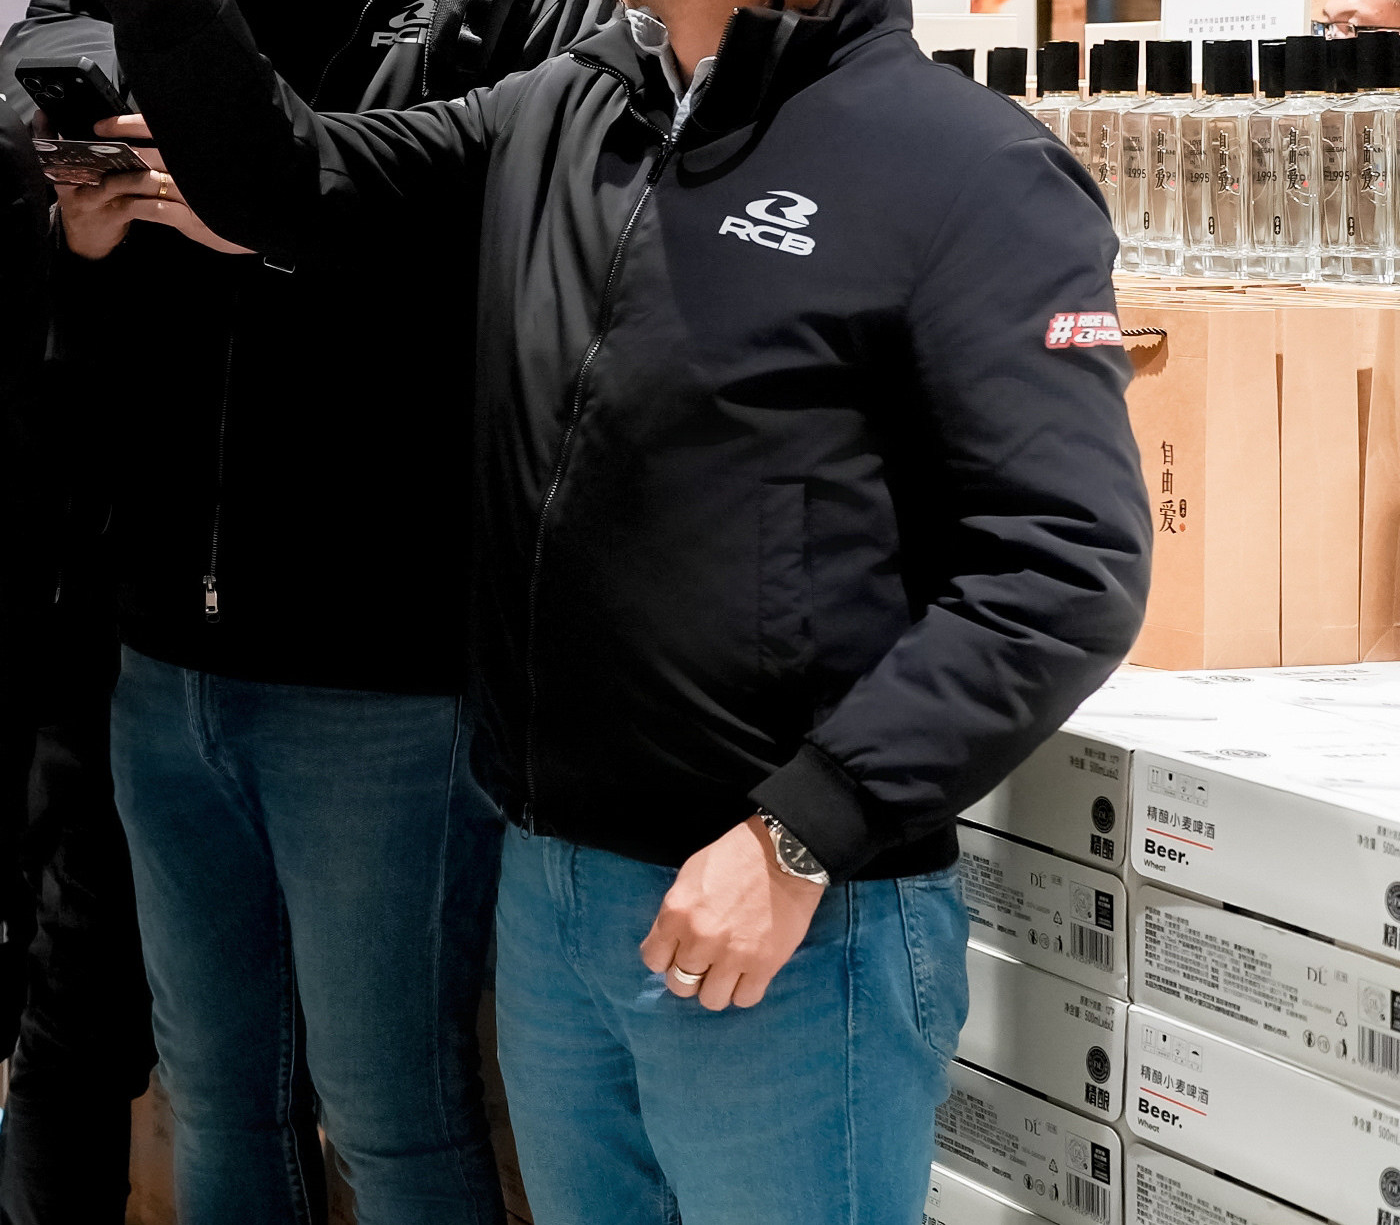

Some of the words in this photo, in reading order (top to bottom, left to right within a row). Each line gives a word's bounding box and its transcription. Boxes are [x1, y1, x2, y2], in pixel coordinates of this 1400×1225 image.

[1127, 168, 1147, 179] 1995
[1189, 172, 1210, 183] 1995
[1256, 171, 1277, 182] 1995
[718, 215, 816, 256] RCB
[1159, 440, 1177, 534] 自由爱
[1147, 805, 1215, 840] 精酿小麦啤酒
[1090, 834, 1115, 862] 精酿
[1144, 838, 1189, 866] Beer.
[1143, 858, 1166, 872] Wheat
[1084, 1082, 1110, 1112] 精酿
[1140, 1064, 1209, 1106] 精酿小麦啤酒
[1137, 1117, 1160, 1133] Wheat
[1138, 1096, 1183, 1130] Beer.
